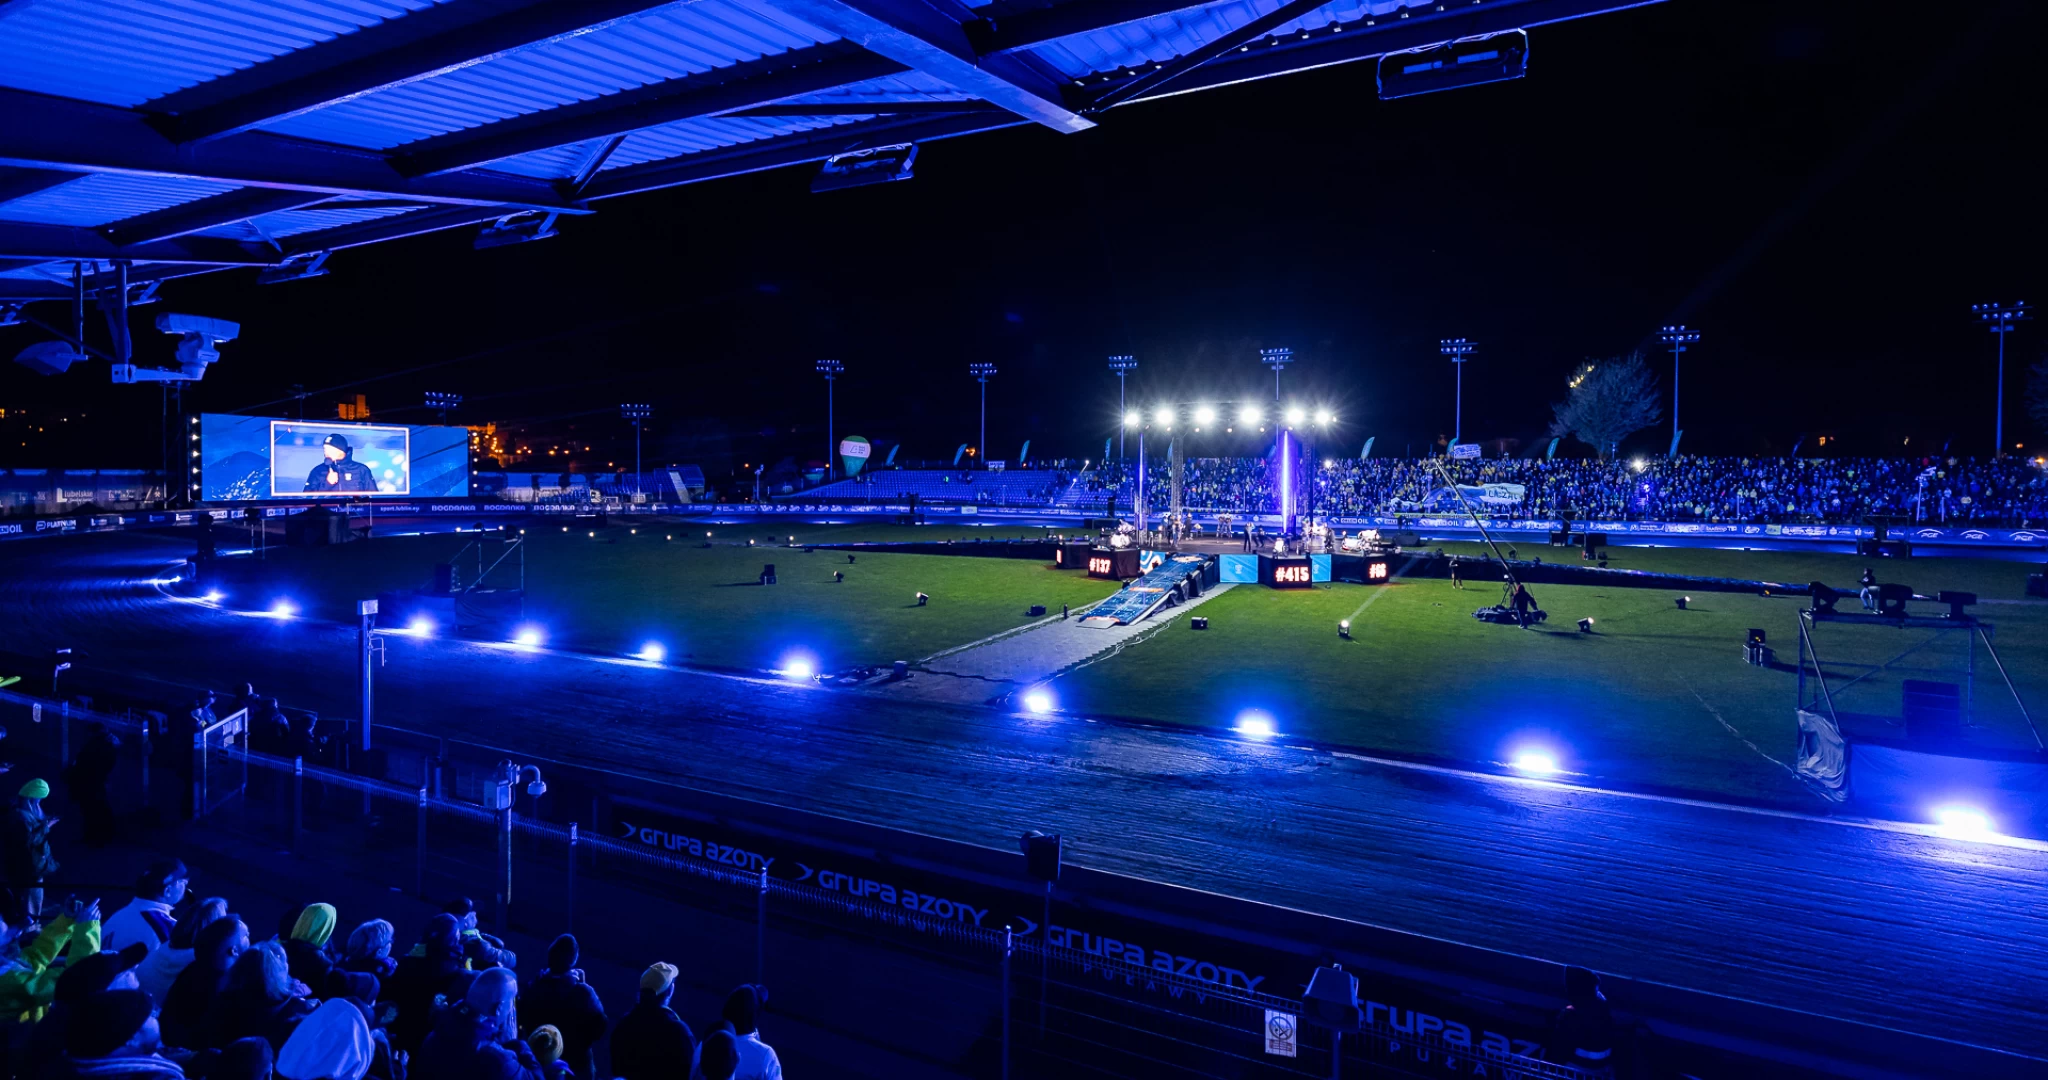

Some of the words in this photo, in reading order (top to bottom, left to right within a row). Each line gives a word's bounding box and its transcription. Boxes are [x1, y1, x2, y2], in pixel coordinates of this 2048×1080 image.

[10, 524, 23, 533] OIL
[1089, 558, 1111, 574] #137
[1275, 567, 1309, 582] #415
[900, 888, 988, 926] AZOTY
[1151, 950, 1265, 995] AZOTY
